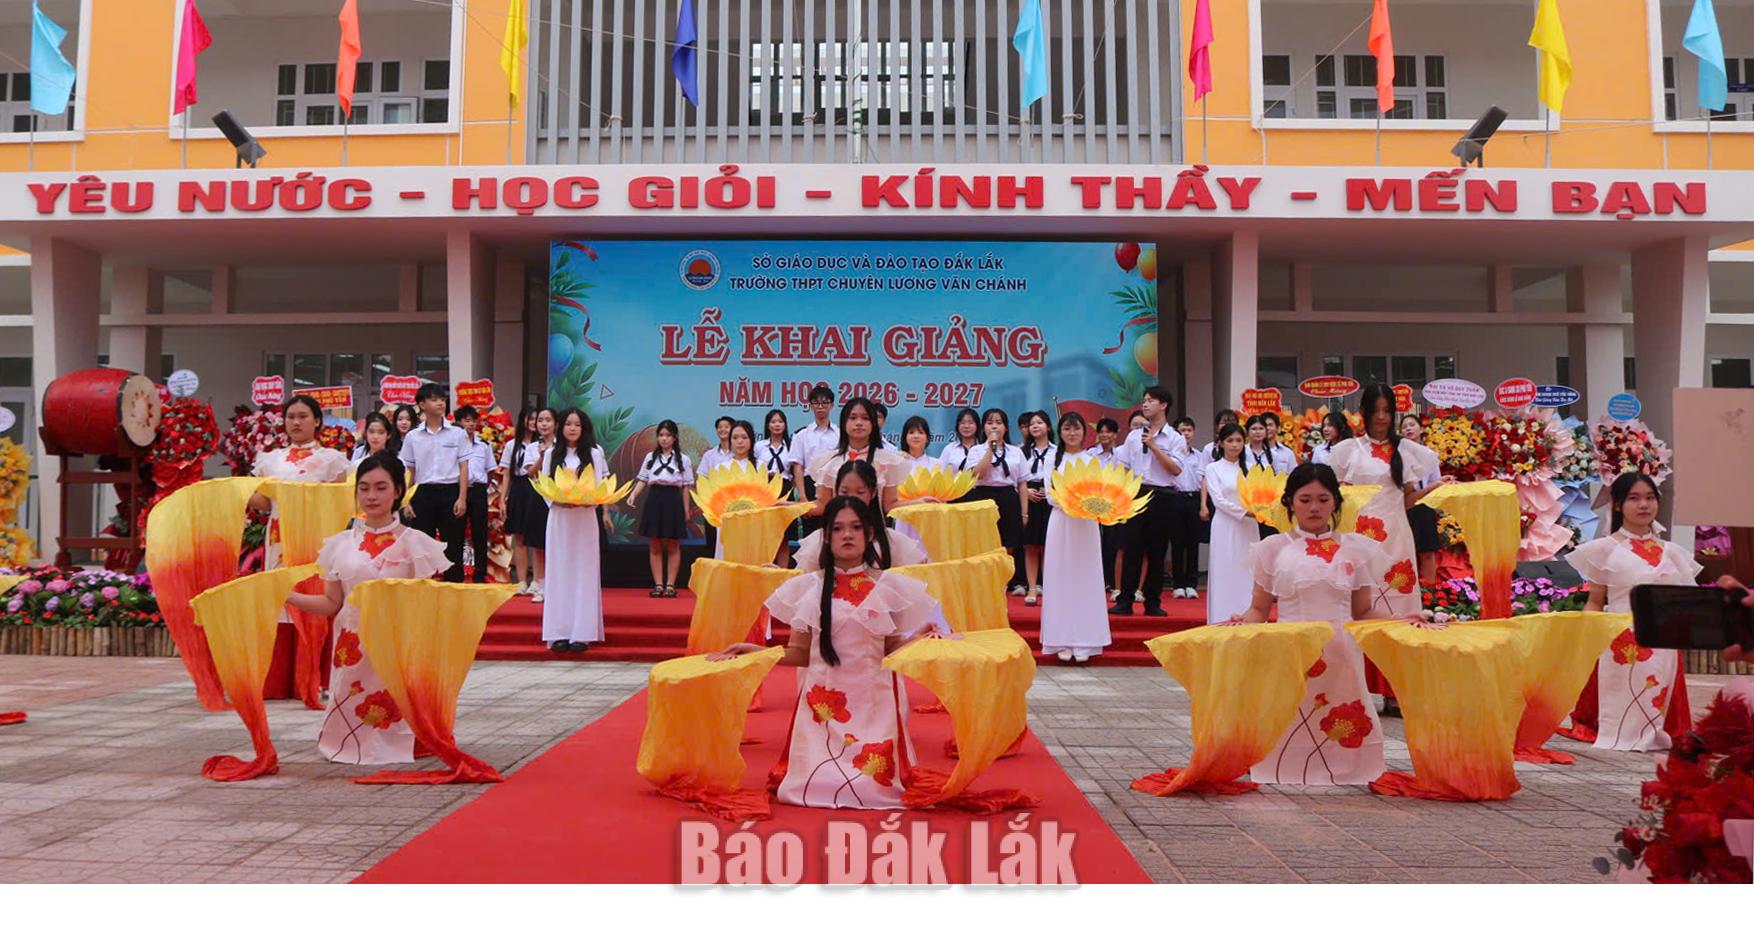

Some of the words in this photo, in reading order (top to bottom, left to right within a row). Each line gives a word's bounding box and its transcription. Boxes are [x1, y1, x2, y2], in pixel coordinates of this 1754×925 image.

[27, 175, 154, 213] YÊU
[178, 172, 372, 212] NƯỚC
[399, 191, 425, 199] -
[452, 176, 599, 216] HỌC
[628, 165, 776, 209] GIỎI
[805, 190, 832, 199] -
[861, 167, 1044, 209] KÍNH
[1070, 165, 1262, 211] THẦY
[1291, 191, 1317, 200] -
[1346, 168, 1518, 213] MẾN
[1551, 180, 1706, 220] BẠN
[752, 253, 773, 269] SỞ
[776, 253, 813, 269] GIÁO
[817, 257, 848, 272] DỤC
[852, 254, 872, 270] VÀ
[876, 254, 907, 270] ĐÀO
[912, 257, 940, 272] TẠO
[944, 252, 974, 270] ĐẮK
[978, 252, 1004, 270] LẮK
[730, 275, 787, 290] TRƯỜNG
[791, 277, 824, 290] THPT
[827, 275, 884, 291] CHUYÊN
[888, 278, 937, 291] LƯƠNG
[941, 276, 971, 291] VĂN
[975, 276, 1027, 291] CHÁNH
[661, 307, 731, 366] LỄ
[740, 323, 872, 366] KHAI
[882, 313, 1048, 369] GIẢNG
[719, 376, 774, 407] NĂM
[780, 381, 829, 412] HỌ
[838, 381, 899, 407] 2026
[923, 382, 985, 408] 2027
